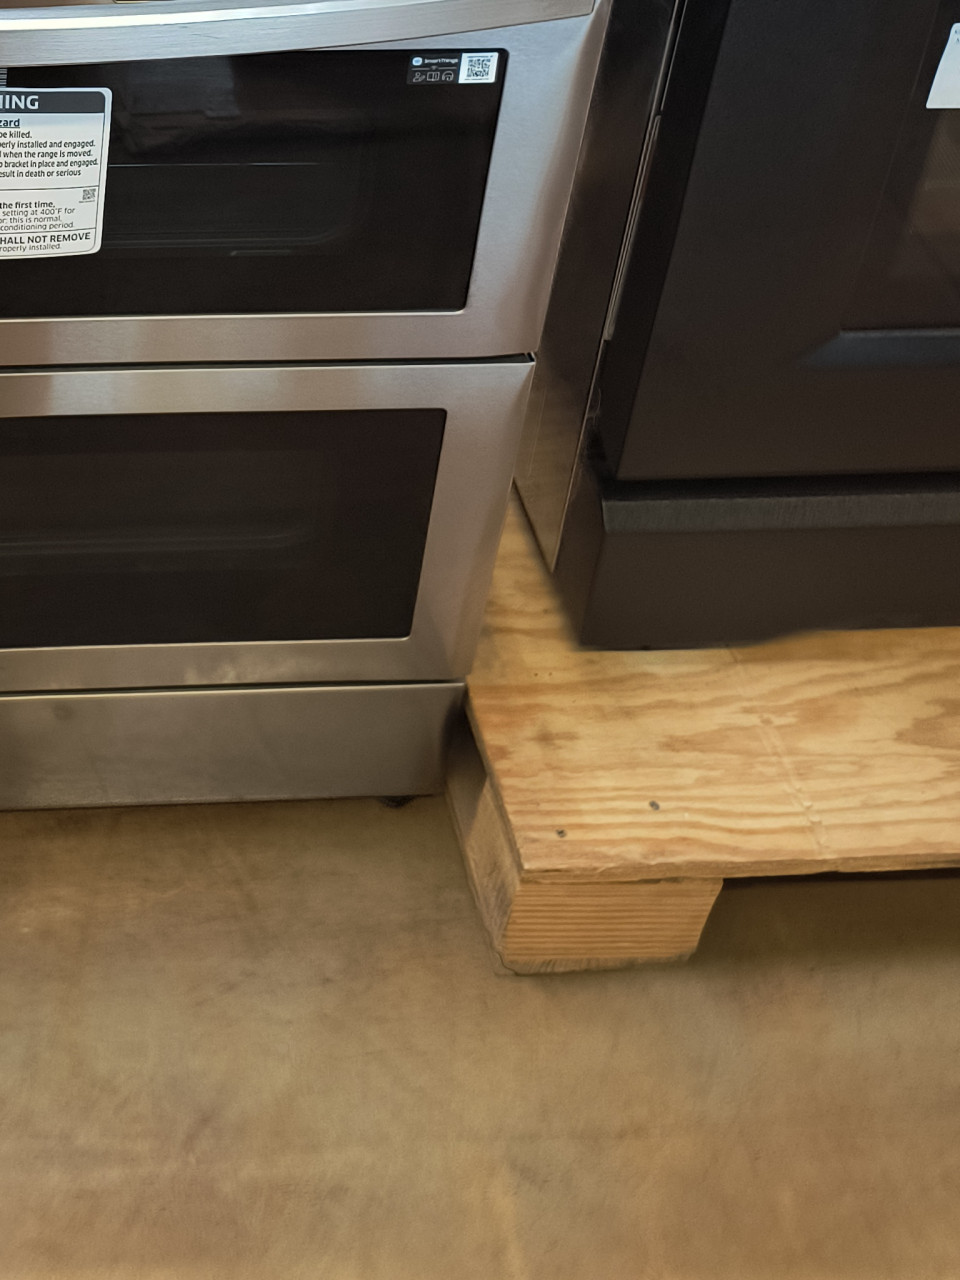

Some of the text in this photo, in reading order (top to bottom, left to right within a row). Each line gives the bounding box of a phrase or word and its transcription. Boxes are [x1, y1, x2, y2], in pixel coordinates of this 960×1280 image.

[9, 131, 32, 139] killed.
[17, 140, 47, 148] installed
[49, 140, 63, 148] and
[64, 139, 96, 150] engaged.
[3, 150, 23, 158] when
[24, 150, 36, 158] the
[60, 150, 65, 158] is
[67, 150, 93, 158] moved.
[4, 160, 29, 168] bracket
[30, 160, 37, 168] in
[38, 160, 55, 169] place
[70, 158, 98, 168] engaged.
[56, 169, 82, 177] serious
[0, 201, 13, 209] the
[15, 201, 32, 209] first
[2, 209, 29, 218] setting
[27, 235, 48, 244] NOT
[50, 232, 91, 243] REMOVE
